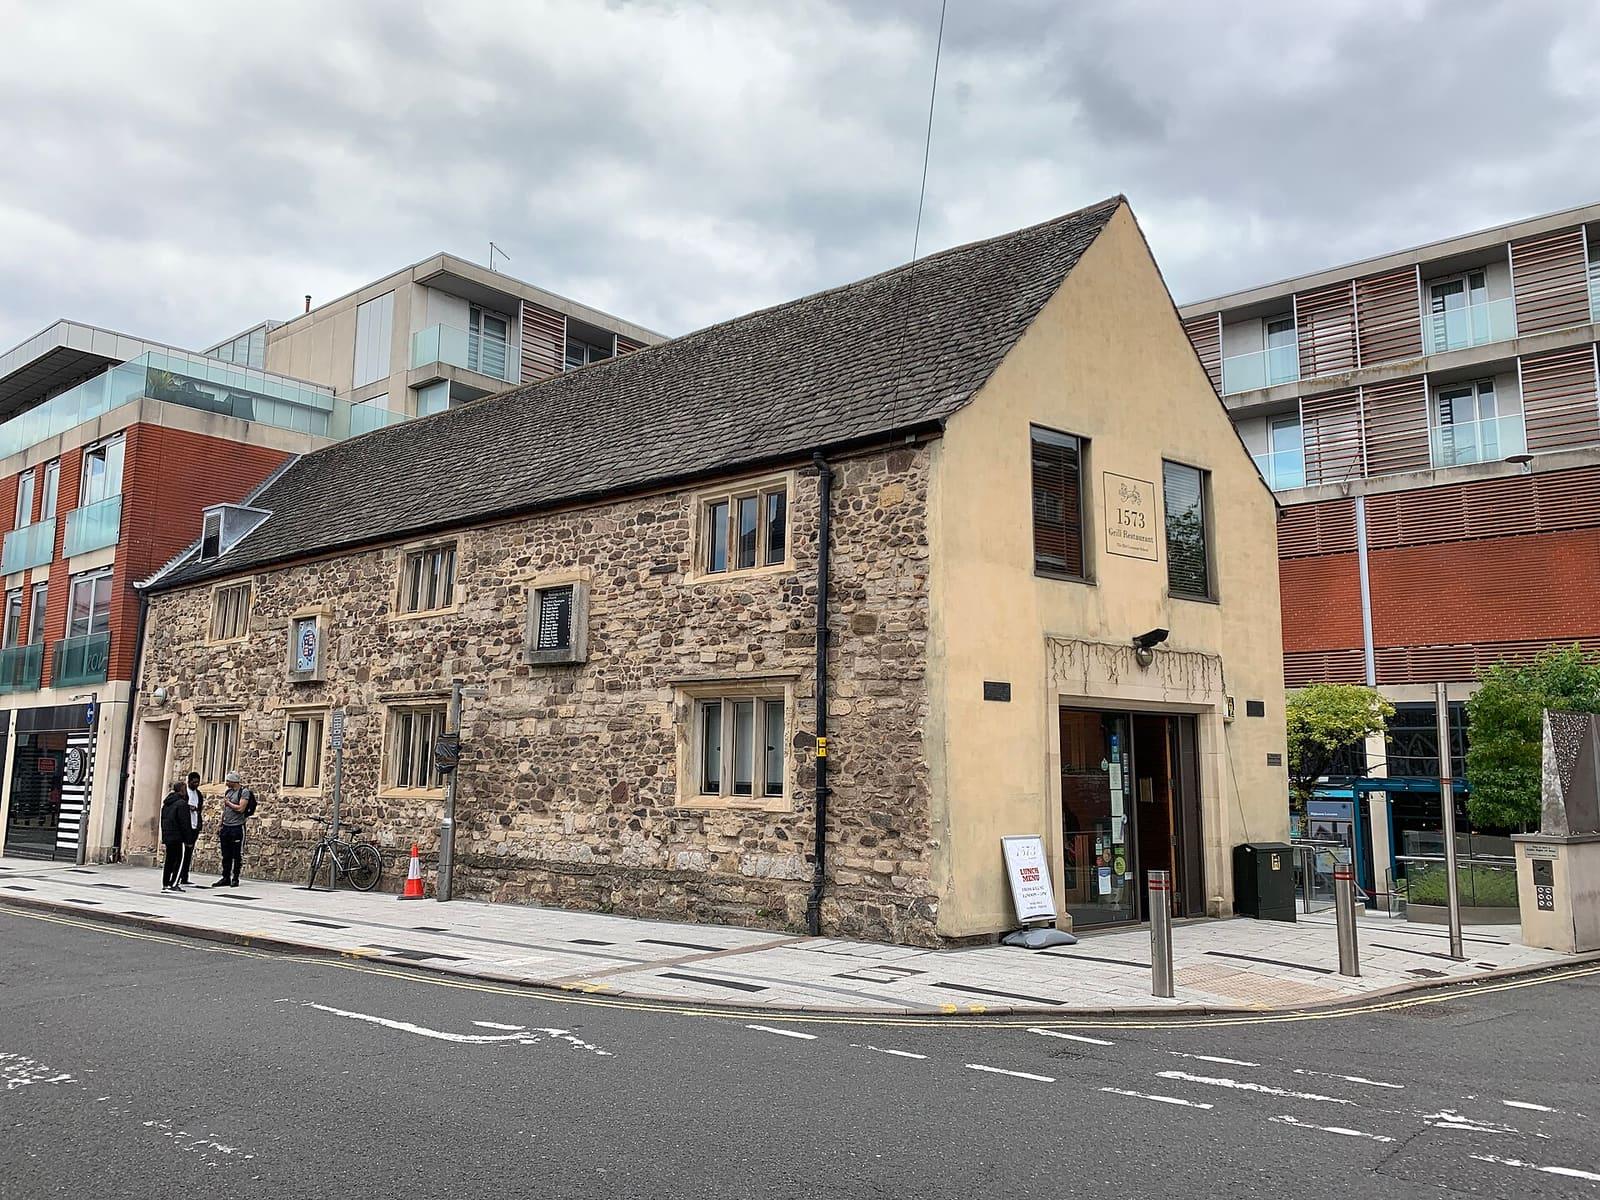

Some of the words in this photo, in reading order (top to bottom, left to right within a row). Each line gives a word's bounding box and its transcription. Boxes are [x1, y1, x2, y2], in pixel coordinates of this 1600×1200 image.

[1117, 508, 1145, 529] 1573
[1108, 527, 1122, 538] Grill
[1123, 529, 1154, 543] Restaurant
